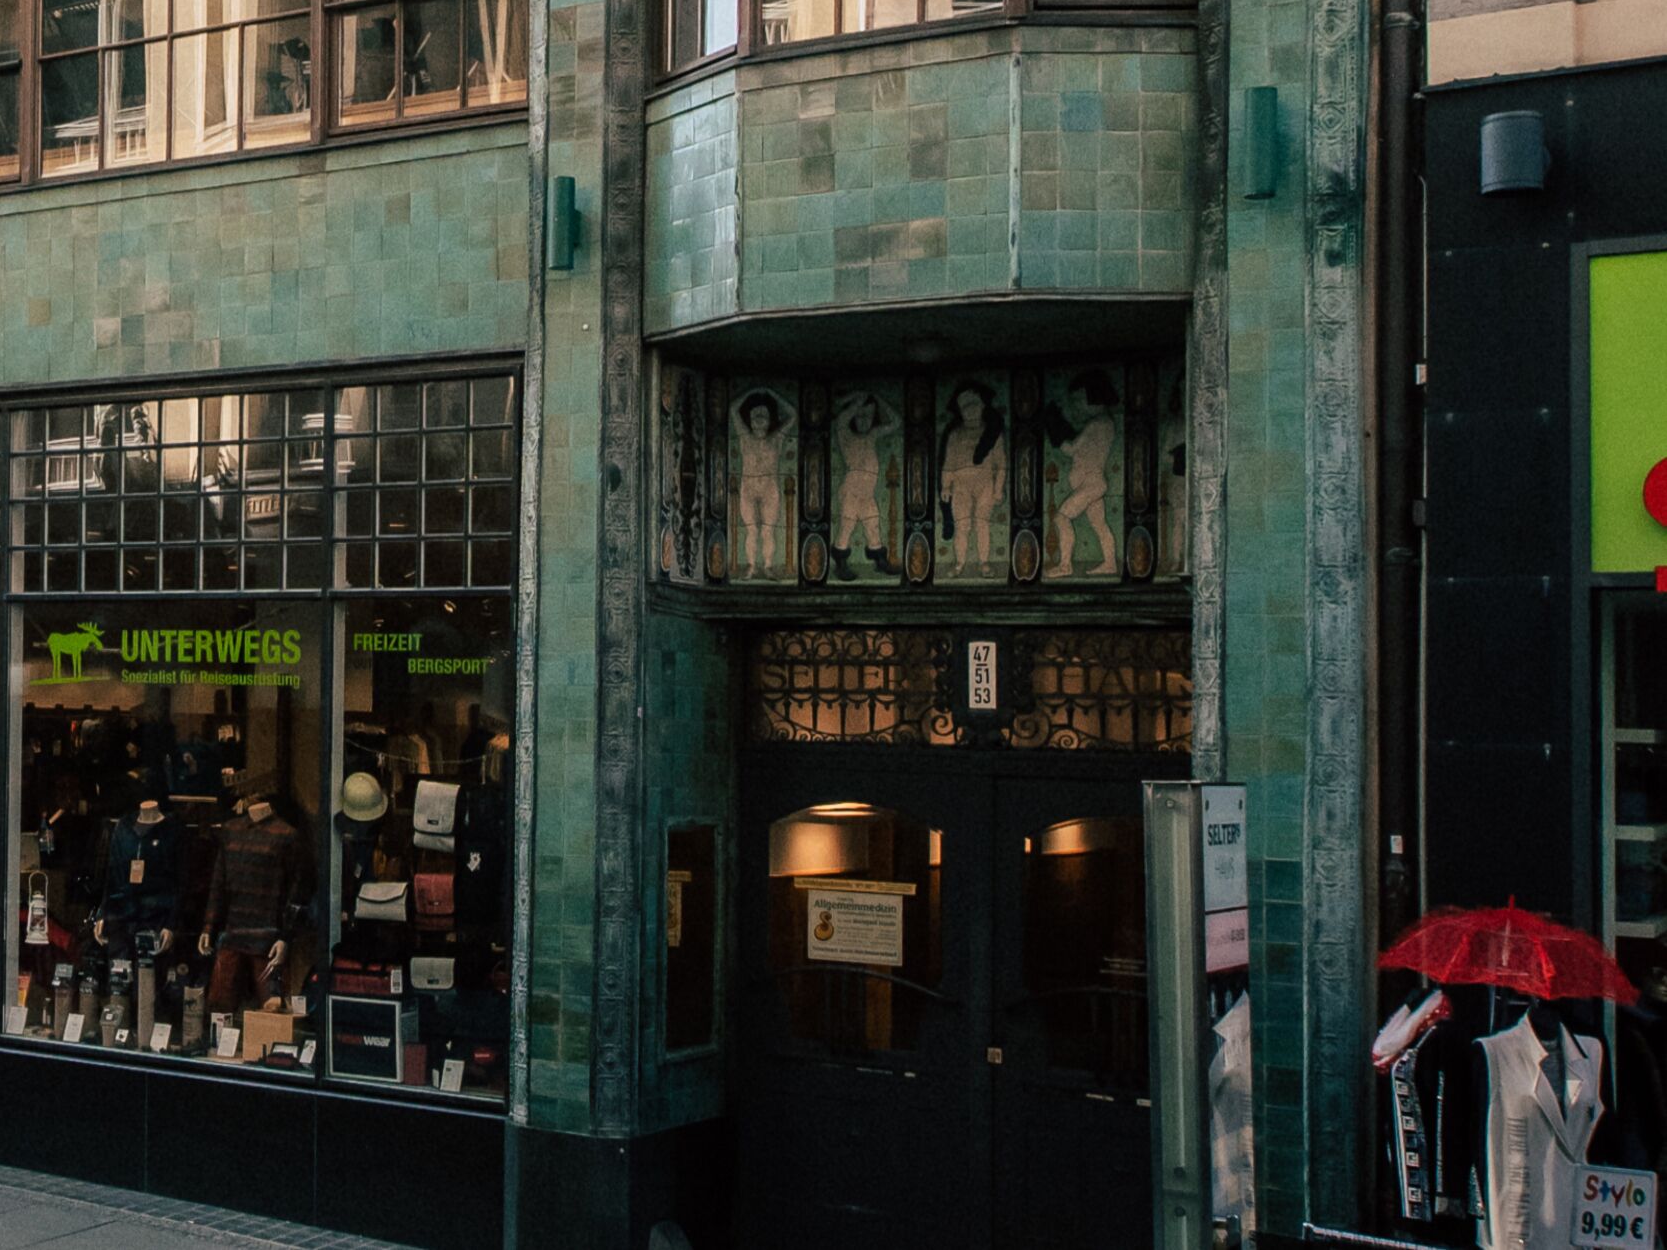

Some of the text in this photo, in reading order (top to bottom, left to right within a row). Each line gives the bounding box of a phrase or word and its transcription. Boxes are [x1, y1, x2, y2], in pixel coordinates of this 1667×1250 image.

[122, 630, 301, 665] UNTERWEGS
[354, 633, 423, 651] FREIZEIT
[973, 645, 991, 662] 47
[408, 658, 489, 674] BERGSPORT
[122, 669, 301, 688] Spezialist für Reiseausrüstung
[973, 668, 991, 685] 51
[973, 688, 991, 705] 53
[813, 898, 897, 914] Allgemeinmedizin
[1583, 1174, 1646, 1208] Stylo
[1581, 1211, 1644, 1240] 9,99 €
